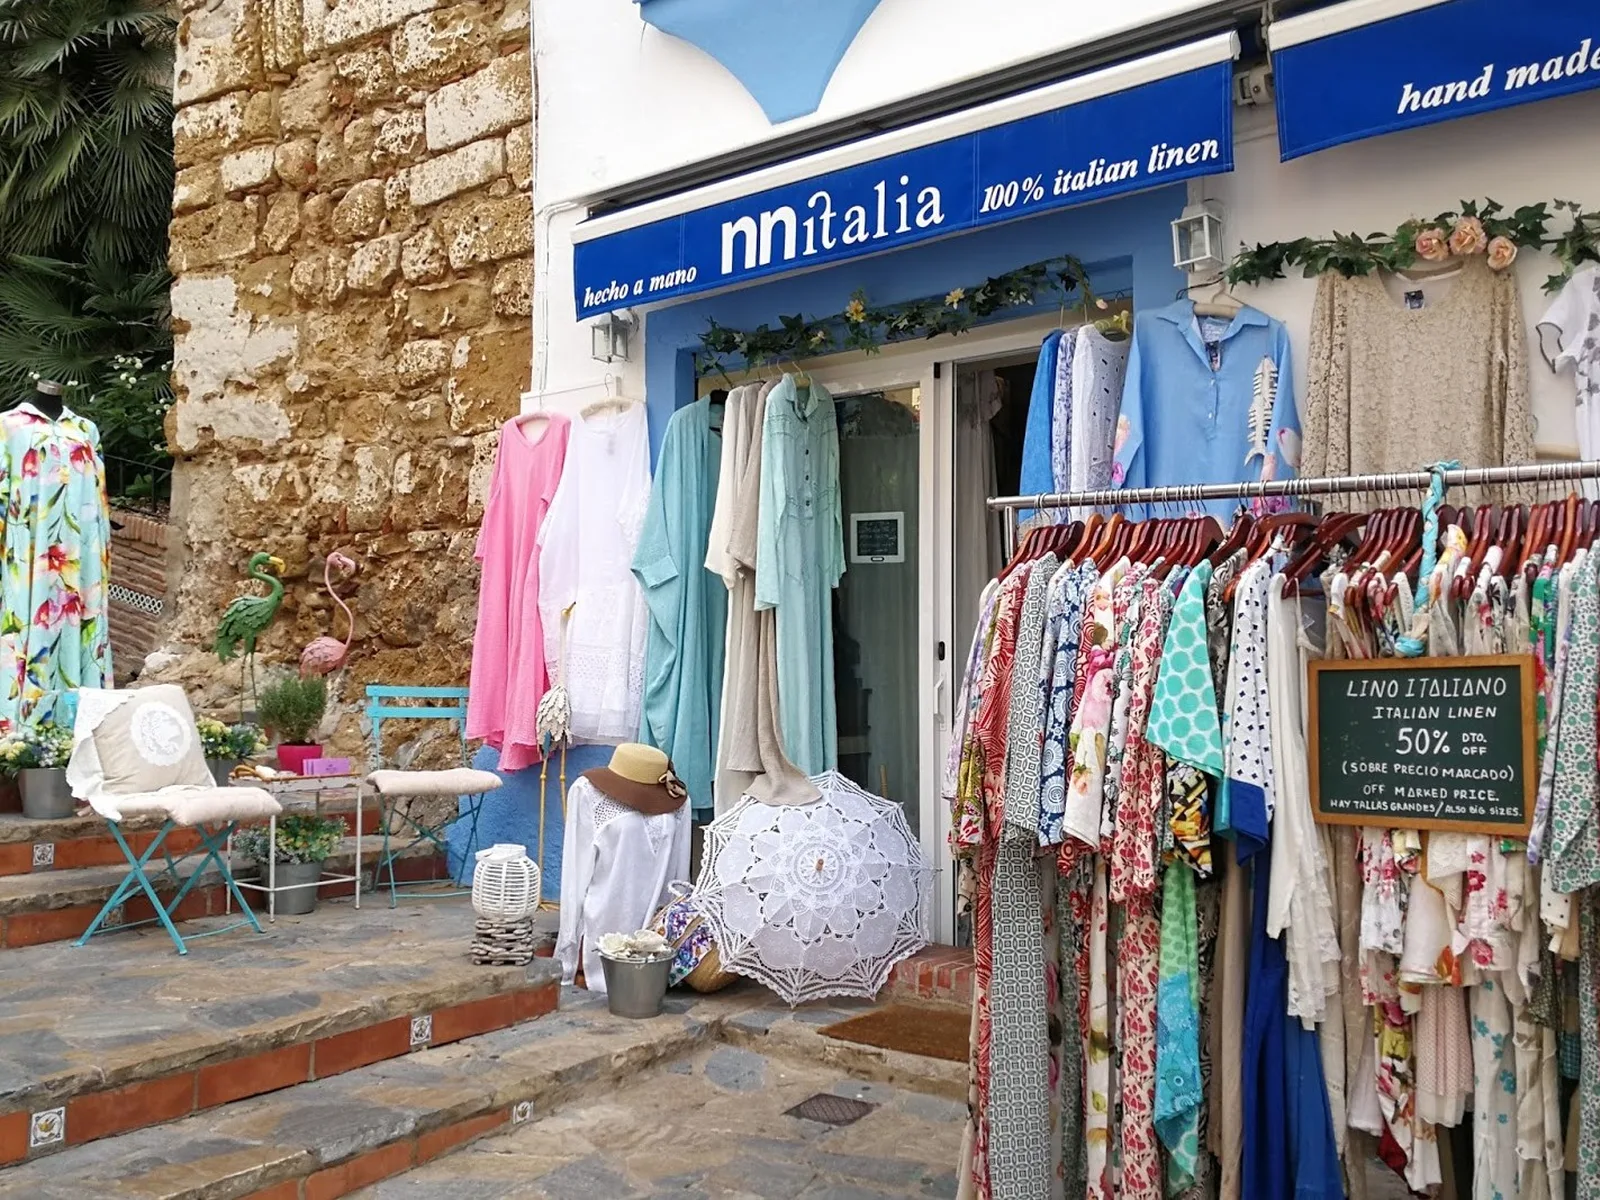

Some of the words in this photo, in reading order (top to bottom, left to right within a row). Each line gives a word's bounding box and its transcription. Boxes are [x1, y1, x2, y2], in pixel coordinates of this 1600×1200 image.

[1397, 63, 1493, 114] hand
[979, 173, 1045, 213] 100%
[1053, 158, 1138, 196] italian
[1147, 138, 1219, 174] linen
[583, 286, 629, 308] hecho
[633, 279, 644, 296] a
[649, 266, 697, 292] mano
[1346, 679, 1399, 699] LINO
[1404, 676, 1507, 699] ITALIANO
[1371, 706, 1440, 720] ITALIAN
[1447, 705, 1497, 719] LINEN
[1395, 726, 1451, 756] 50%
[1461, 732, 1488, 743] DTO.
[1461, 745, 1488, 756] OFF
[1341, 760, 1388, 775] (SOBRE
[1393, 762, 1439, 777] PRECIO
[1441, 764, 1515, 782] MARCADO)
[1362, 783, 1387, 796] OFF
[1394, 786, 1448, 799] MARKED
[1453, 788, 1500, 802] PRICE.
[1330, 799, 1352, 809] HAY
[1352, 800, 1389, 811] TALLAS
